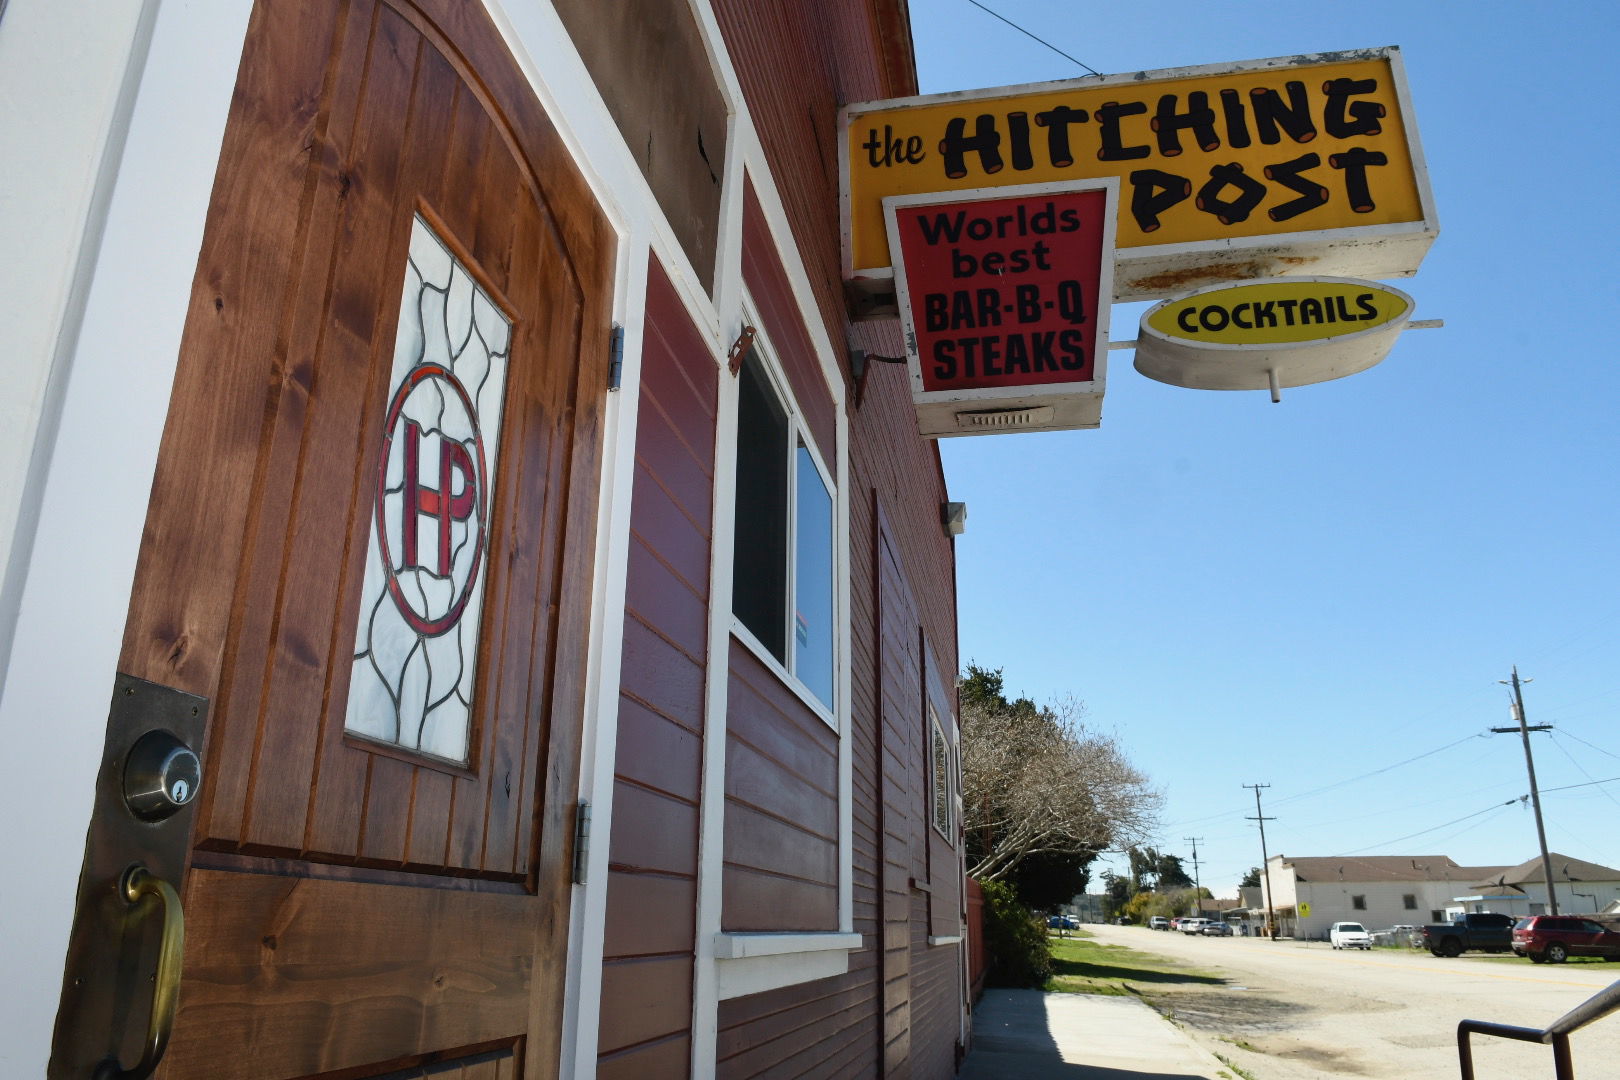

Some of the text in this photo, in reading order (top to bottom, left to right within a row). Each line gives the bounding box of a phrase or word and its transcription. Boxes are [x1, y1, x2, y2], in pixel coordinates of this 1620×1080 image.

[863, 78, 1387, 179] the HITCHING
[1130, 147, 1388, 233] POST
[917, 202, 1081, 246] Worlds
[952, 240, 1052, 279] best
[925, 280, 1087, 333] BAR-B-Q
[1177, 293, 1378, 333] COCKTAILS
[933, 329, 1085, 380] STEAKS
